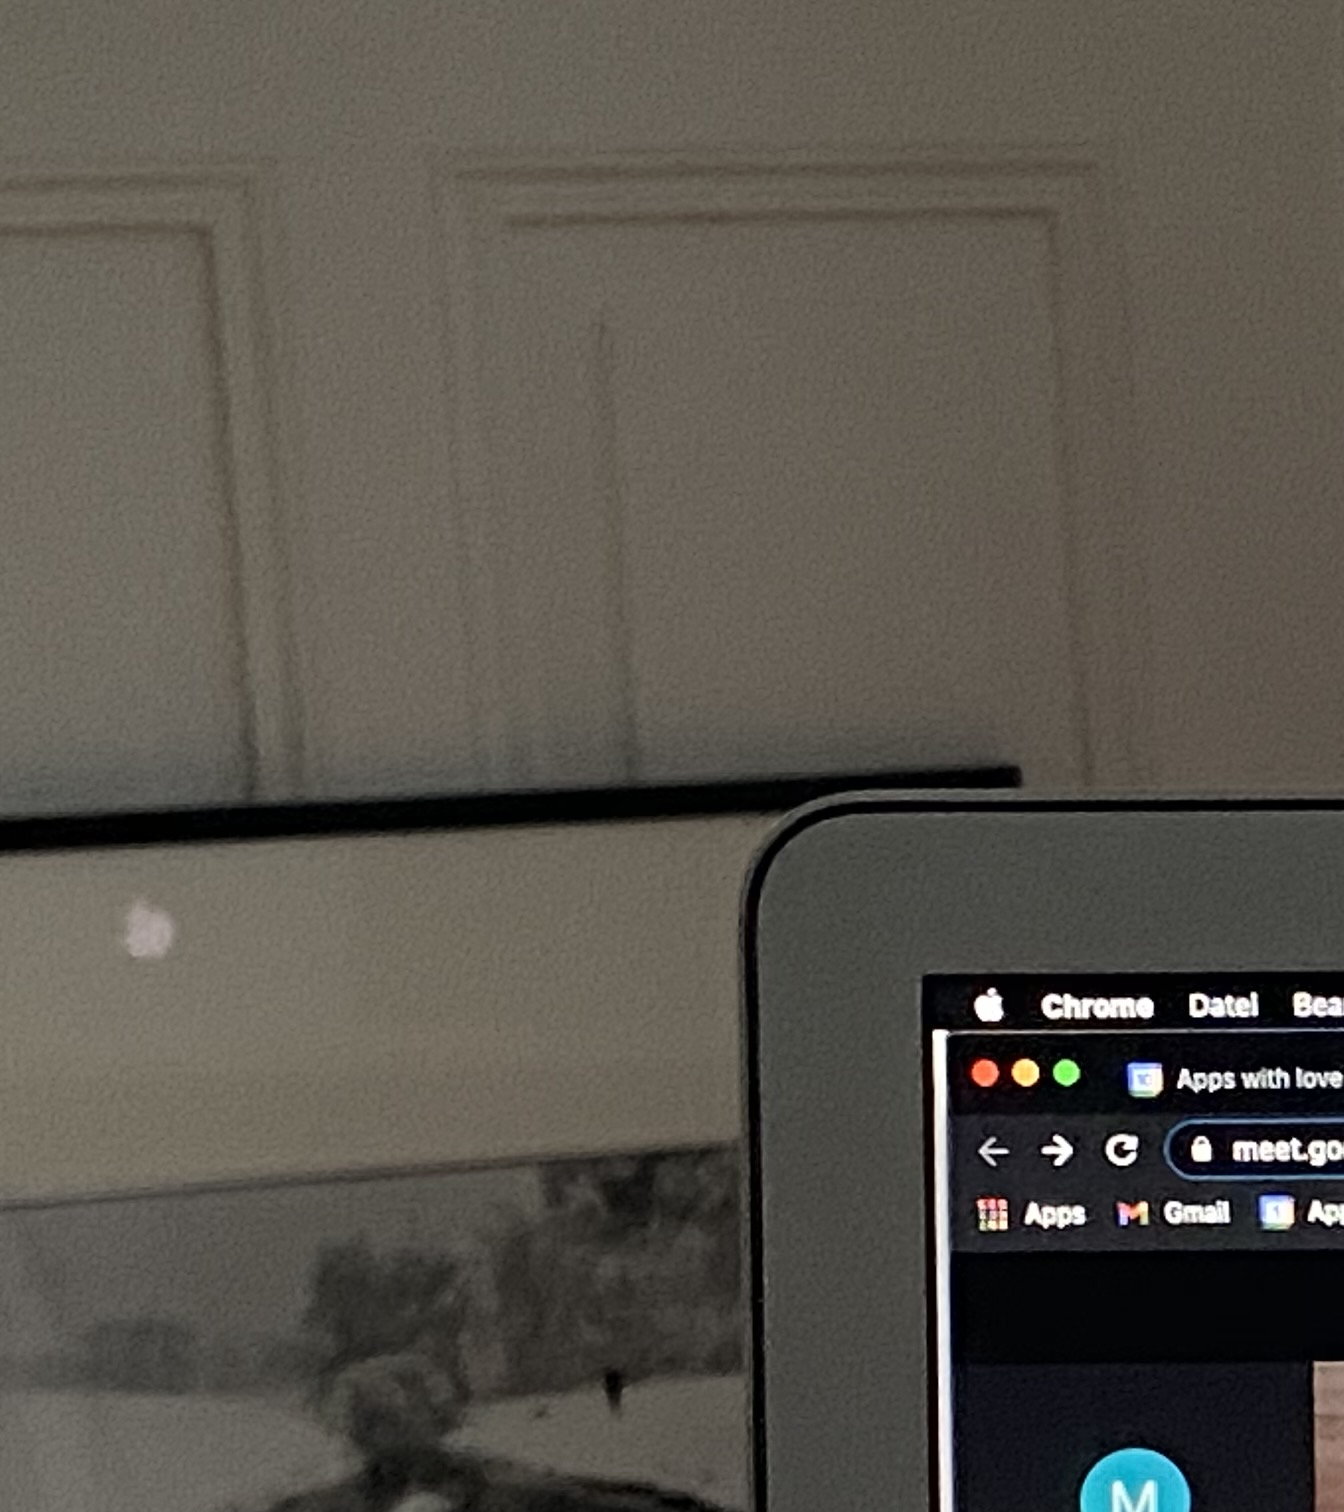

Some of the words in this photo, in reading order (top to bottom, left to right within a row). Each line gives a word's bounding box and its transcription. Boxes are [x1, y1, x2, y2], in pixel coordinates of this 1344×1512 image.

[1042, 994, 1154, 1019] Chrome
[1189, 993, 1259, 1018] Datei
[1177, 1068, 1235, 1093] Apps
[1241, 1068, 1290, 1089] with
[1296, 1067, 1343, 1089] love
[1024, 1202, 1086, 1228] Apps
[1163, 1201, 1231, 1225] Gmail
